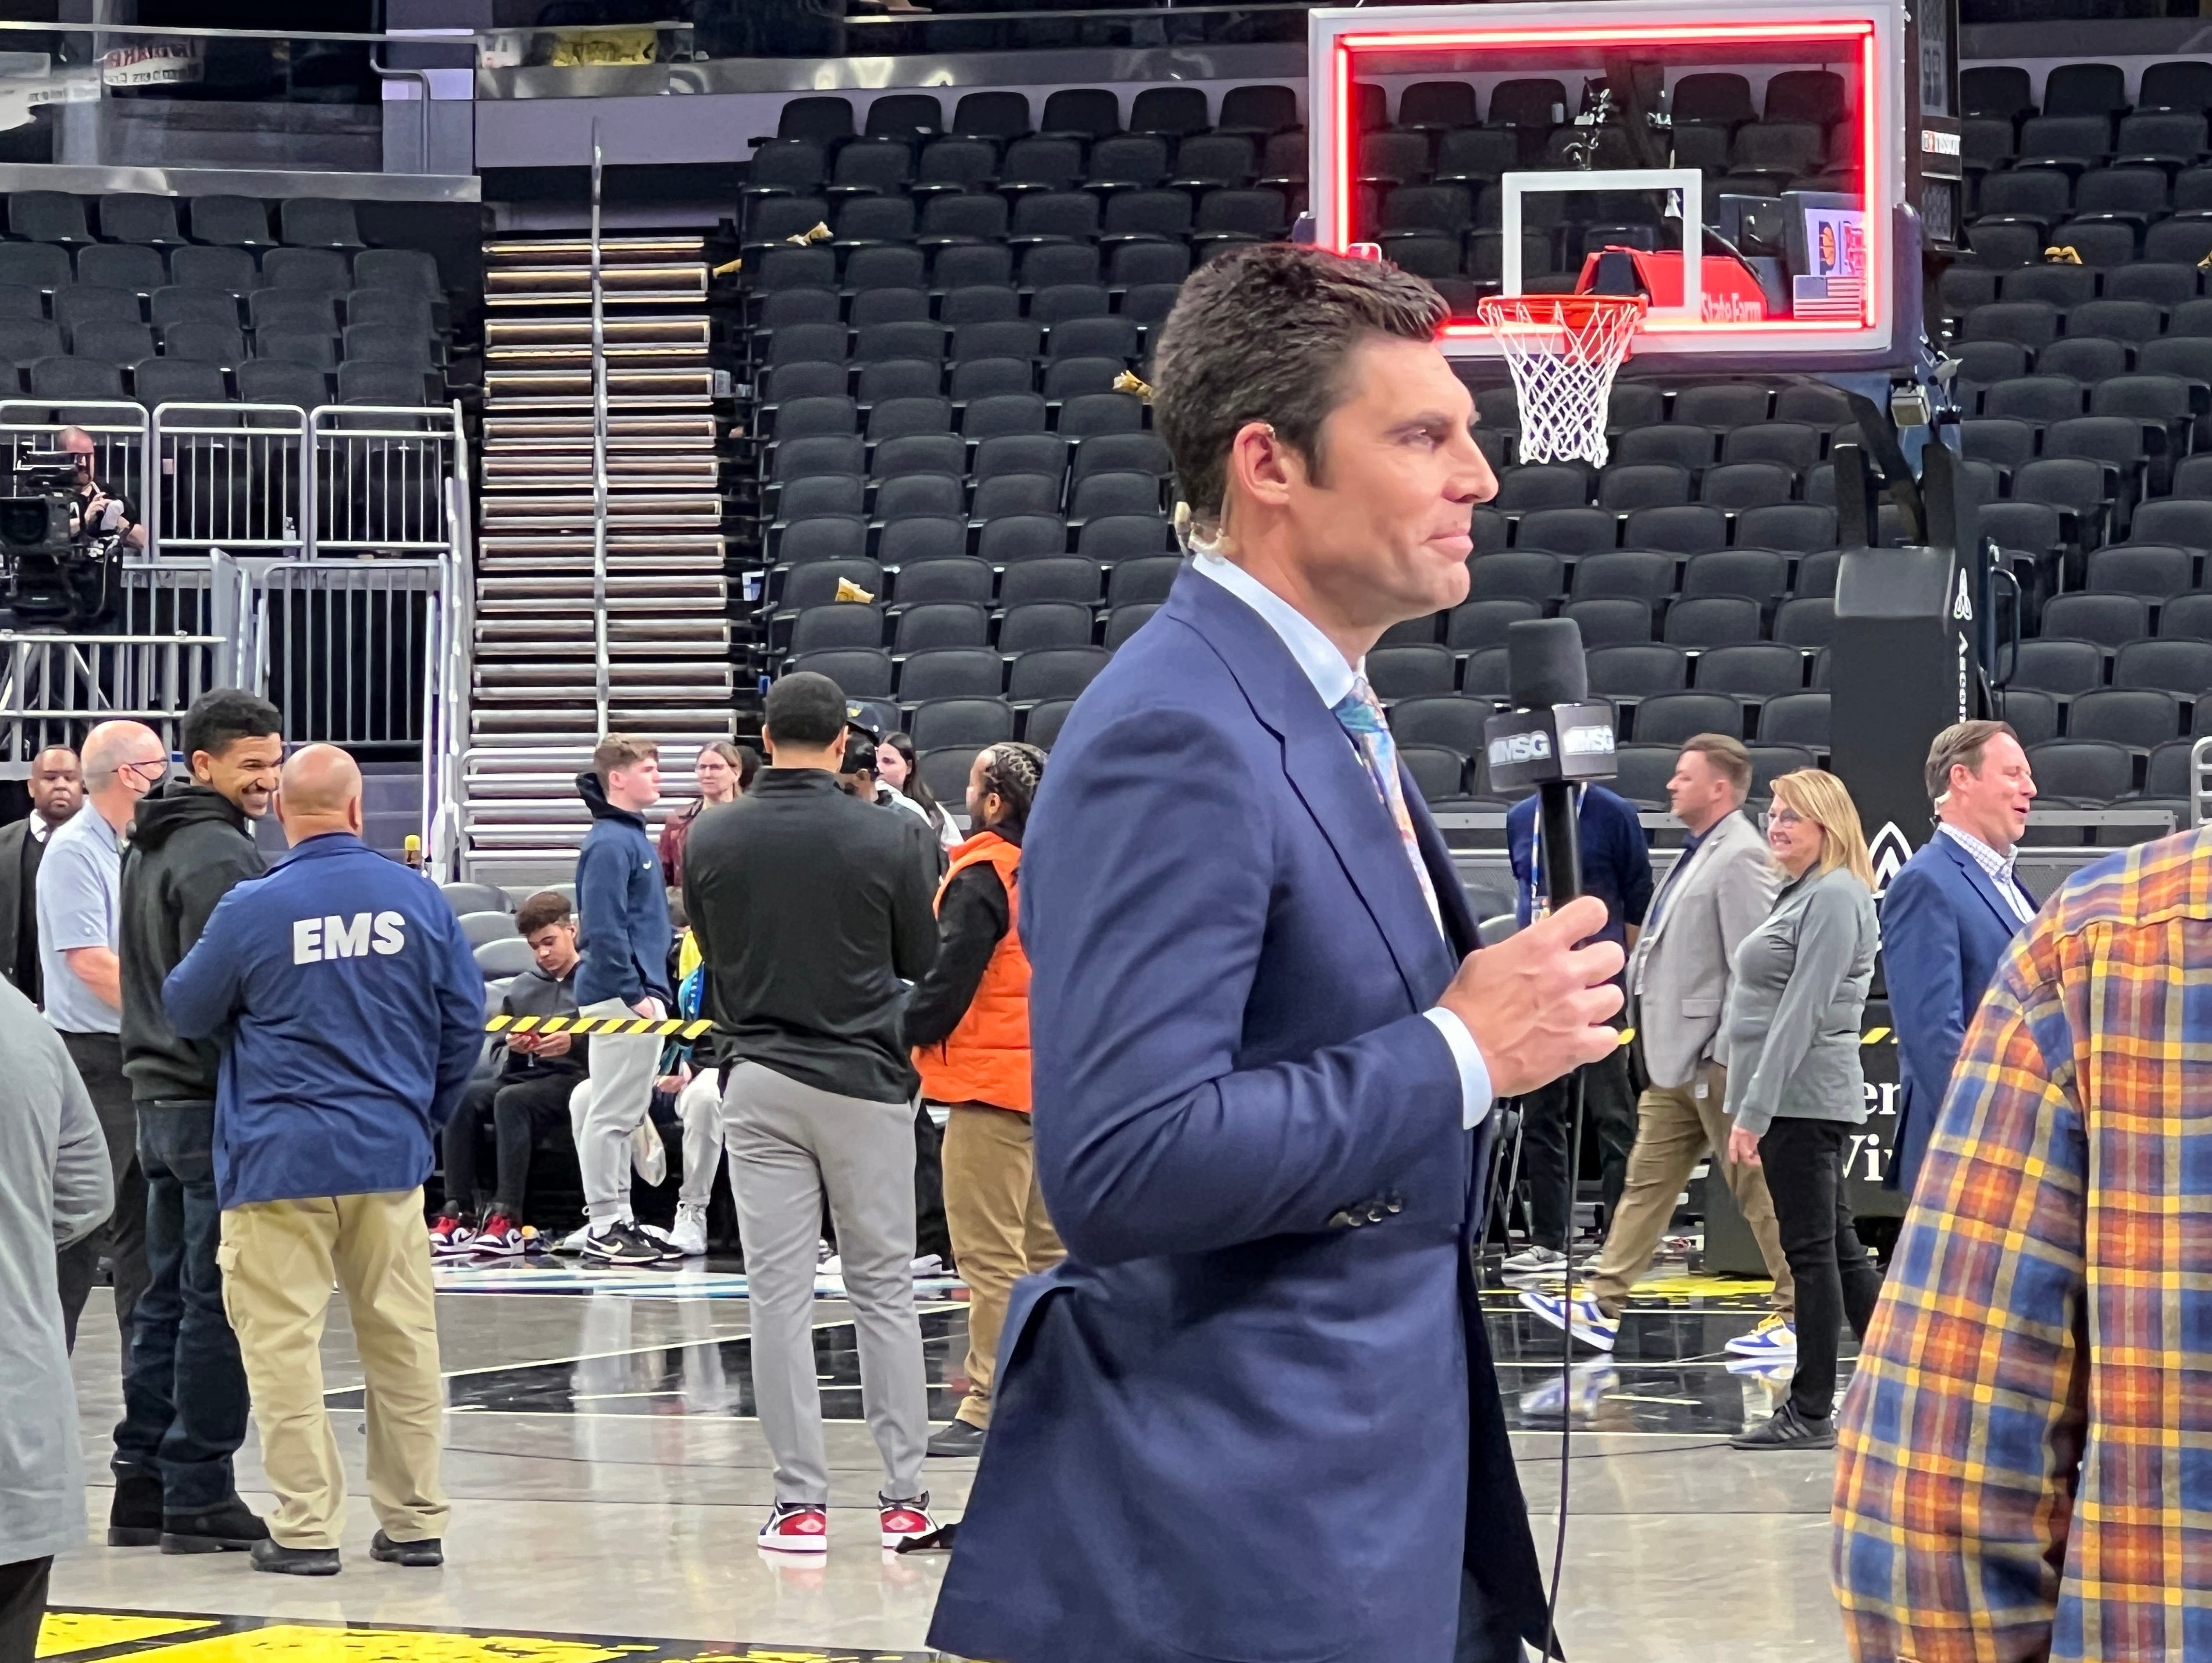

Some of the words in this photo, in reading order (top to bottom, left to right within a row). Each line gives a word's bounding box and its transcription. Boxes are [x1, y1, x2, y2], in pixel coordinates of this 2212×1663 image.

[1489, 734, 1550, 763] MSG
[1563, 727, 1615, 754] MSG
[293, 911, 406, 965] EMS
